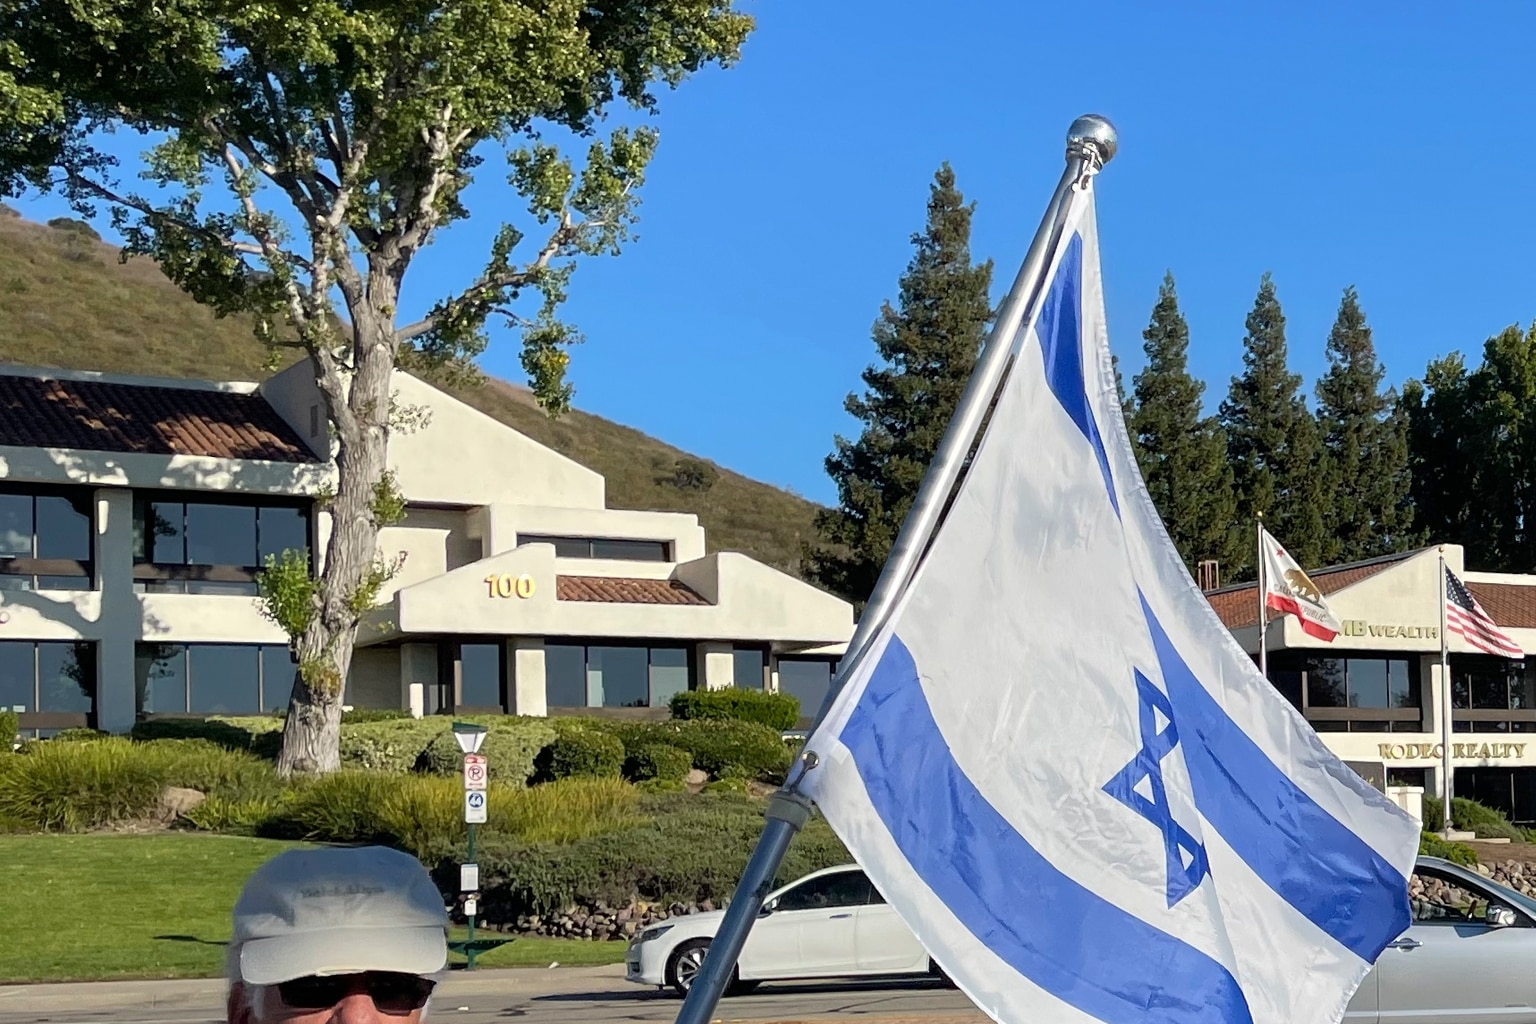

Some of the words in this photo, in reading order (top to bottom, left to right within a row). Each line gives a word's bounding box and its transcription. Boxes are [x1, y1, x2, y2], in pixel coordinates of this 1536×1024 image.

[483, 573, 536, 599] 100
[1368, 625, 1439, 639] WEALTH
[1378, 743, 1444, 759] RODEO
[1452, 743, 1527, 758] REALTY
